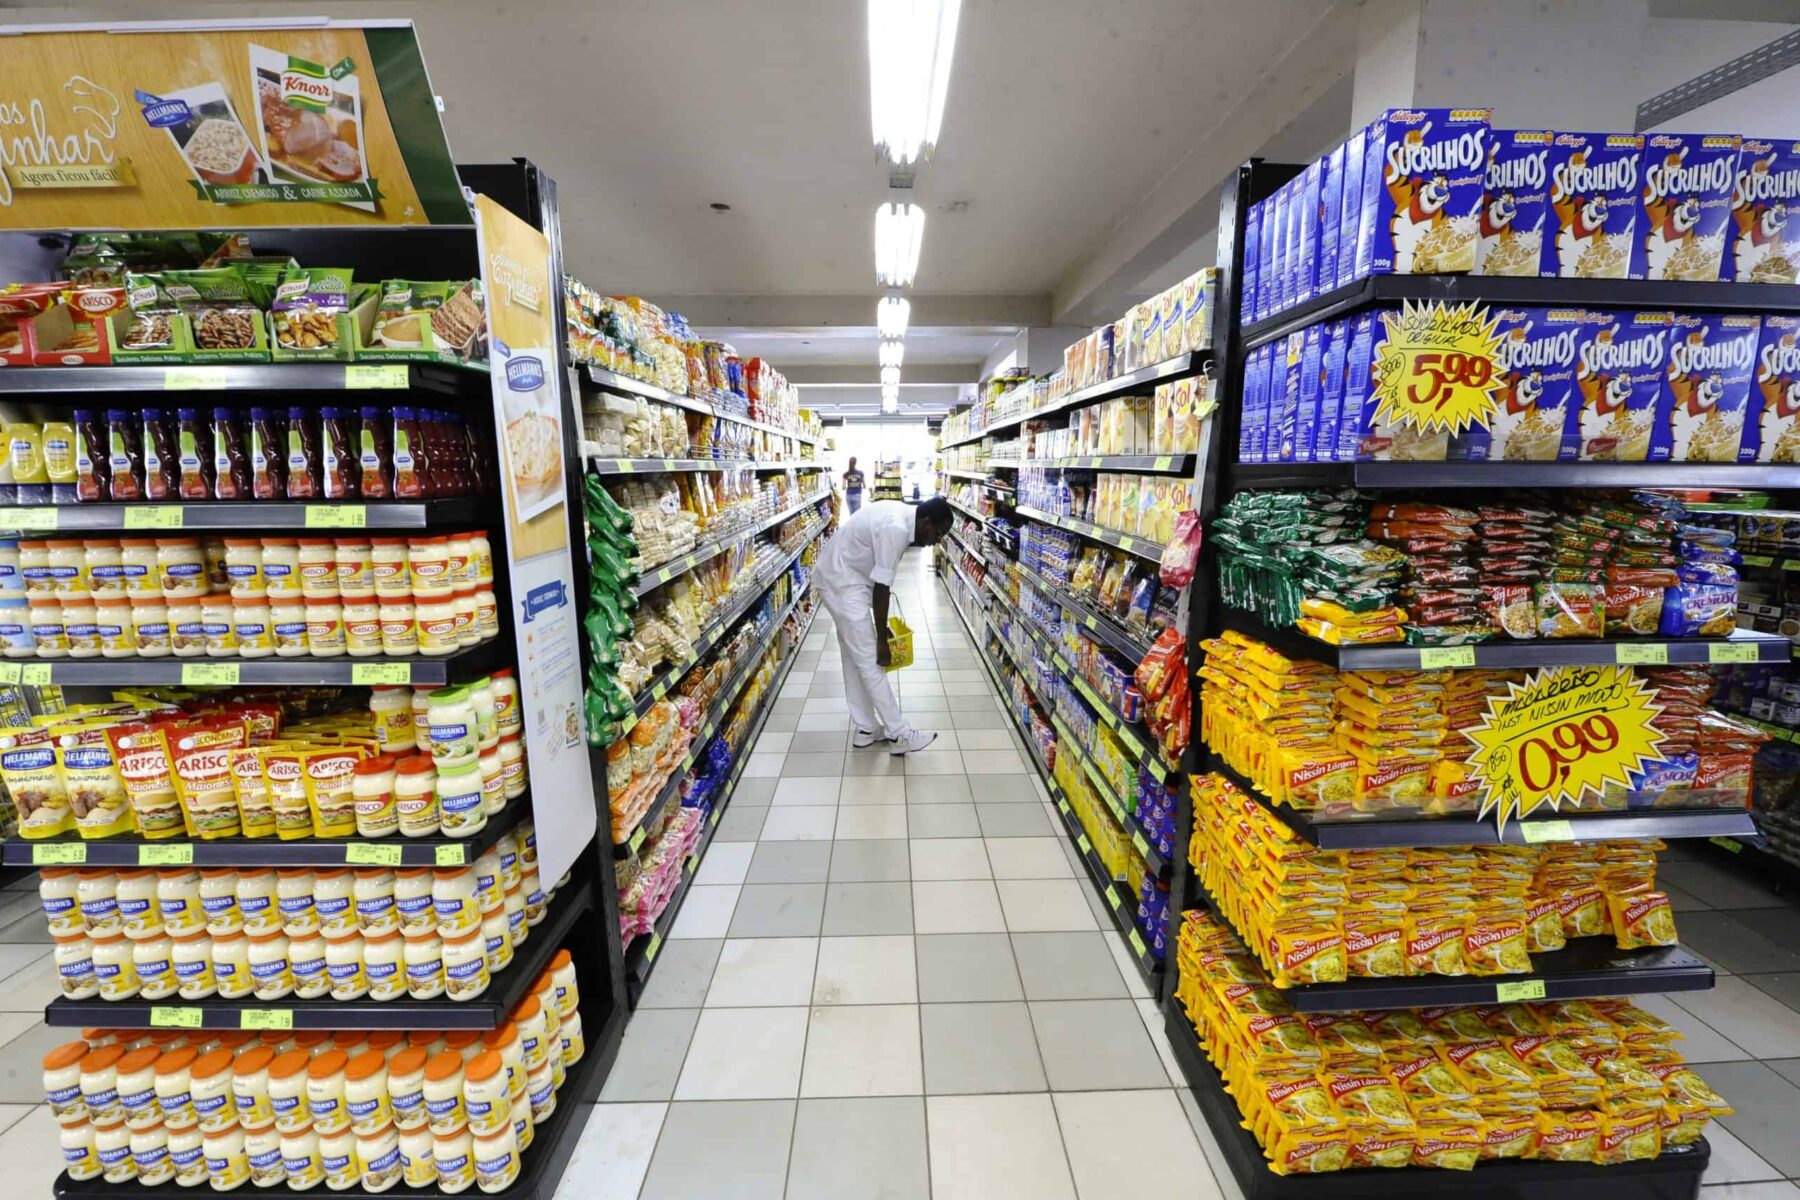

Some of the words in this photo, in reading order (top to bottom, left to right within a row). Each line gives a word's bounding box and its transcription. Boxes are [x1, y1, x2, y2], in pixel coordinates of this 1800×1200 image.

[283, 75, 331, 97] Knorr
[1390, 111, 1427, 123] Kellogg's
[1650, 135, 1683, 148] Kellogg's
[1386, 128, 1488, 184] SUCRILHOS
[20, 169, 55, 187] Agora
[56, 169, 89, 182] ficou
[1485, 150, 1549, 190] CRILHOS
[1552, 153, 1641, 204] SUCRILHOS
[1644, 153, 1737, 205] SUCRILHOS
[283, 186, 297, 200] &
[300, 187, 328, 199] CARNE
[1373, 259, 1391, 268] 300g
[82, 294, 114, 307] ARISCO
[1403, 315, 1481, 337] SUCRILHOS
[1501, 328, 1580, 368] UCRILHOS
[1577, 329, 1668, 381] SUCRILHOS
[1668, 333, 1756, 381] SUCRILHOS
[1407, 353, 1492, 412] 5,99
[1529, 697, 1572, 721] NISSIN
[1518, 714, 1620, 792] 0,99
[179, 754, 228, 771] ARISC
[237, 763, 260, 773] ARIS
[503, 764, 522, 776] RISCO
[1293, 765, 1325, 784] Nissin
[1367, 770, 1400, 788] Nissin
[356, 803, 380, 812] RISCO
[398, 801, 424, 811] RISCO
[1286, 946, 1316, 966] Nissin
[60, 960, 92, 974] HELLMAN
[1513, 1037, 1538, 1055] Nissin
[1331, 1080, 1361, 1094] Nissin
[1604, 1130, 1634, 1149] Nissin
[370, 1150, 399, 1167] HELLMA
